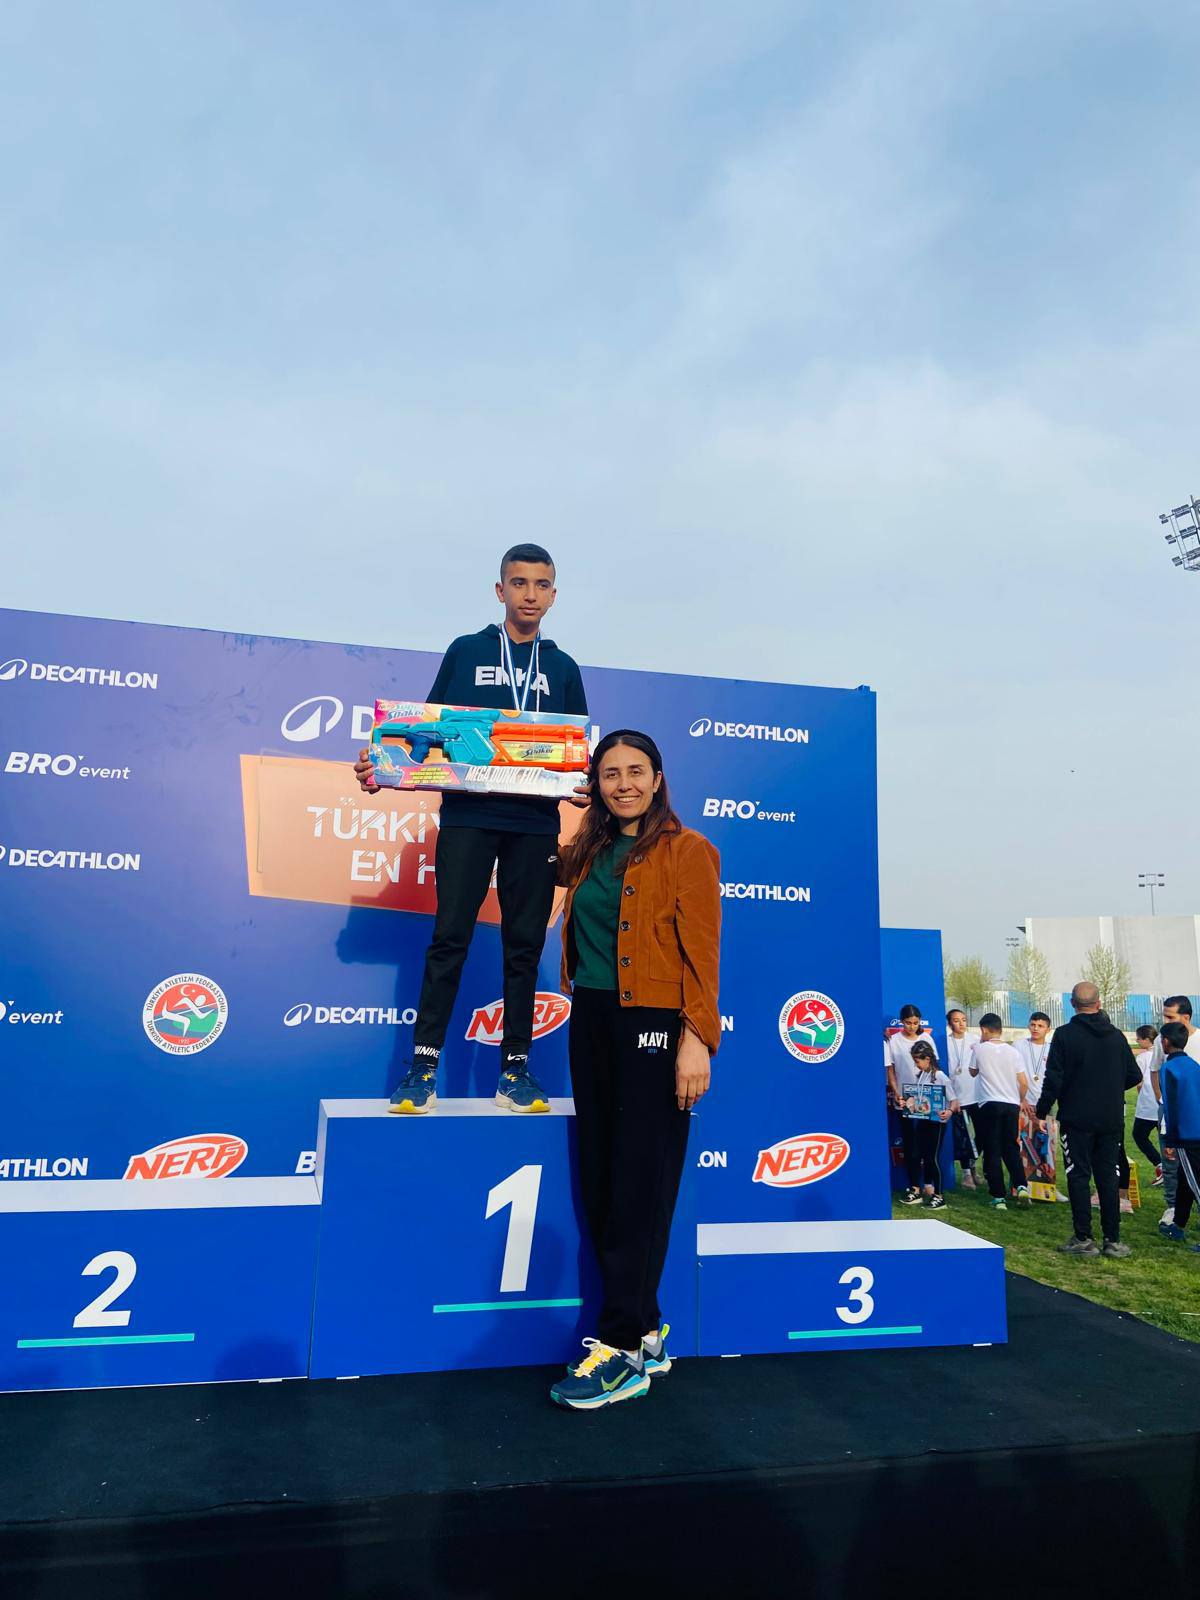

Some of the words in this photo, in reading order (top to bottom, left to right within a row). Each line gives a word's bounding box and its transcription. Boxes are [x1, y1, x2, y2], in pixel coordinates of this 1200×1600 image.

[30, 663, 158, 689] DECATHLON
[475, 666, 550, 696] ENKA
[714, 722, 809, 743] DECATHLON
[4, 751, 77, 777] BRO
[79, 764, 131, 780] event
[703, 798, 756, 819] BRO
[757, 810, 796, 822] event
[8, 849, 141, 871] DECATHLON
[351, 849, 401, 883] EN
[195, 977, 227, 1013] FEDERASYONU
[8, 1010, 64, 1025] event
[314, 1007, 418, 1026] DECATHLO
[161, 1041, 191, 1054] ATHLETIC
[191, 1021, 224, 1052] FEDERATION
[419, 1046, 441, 1059] NIKE
[0, 1157, 88, 1178] ATHLON
[125, 1140, 246, 1180] NERF
[754, 1140, 846, 1181] NERF
[485, 1164, 542, 1293] 1
[73, 1250, 137, 1328] 2
[835, 1266, 875, 1325] 3
